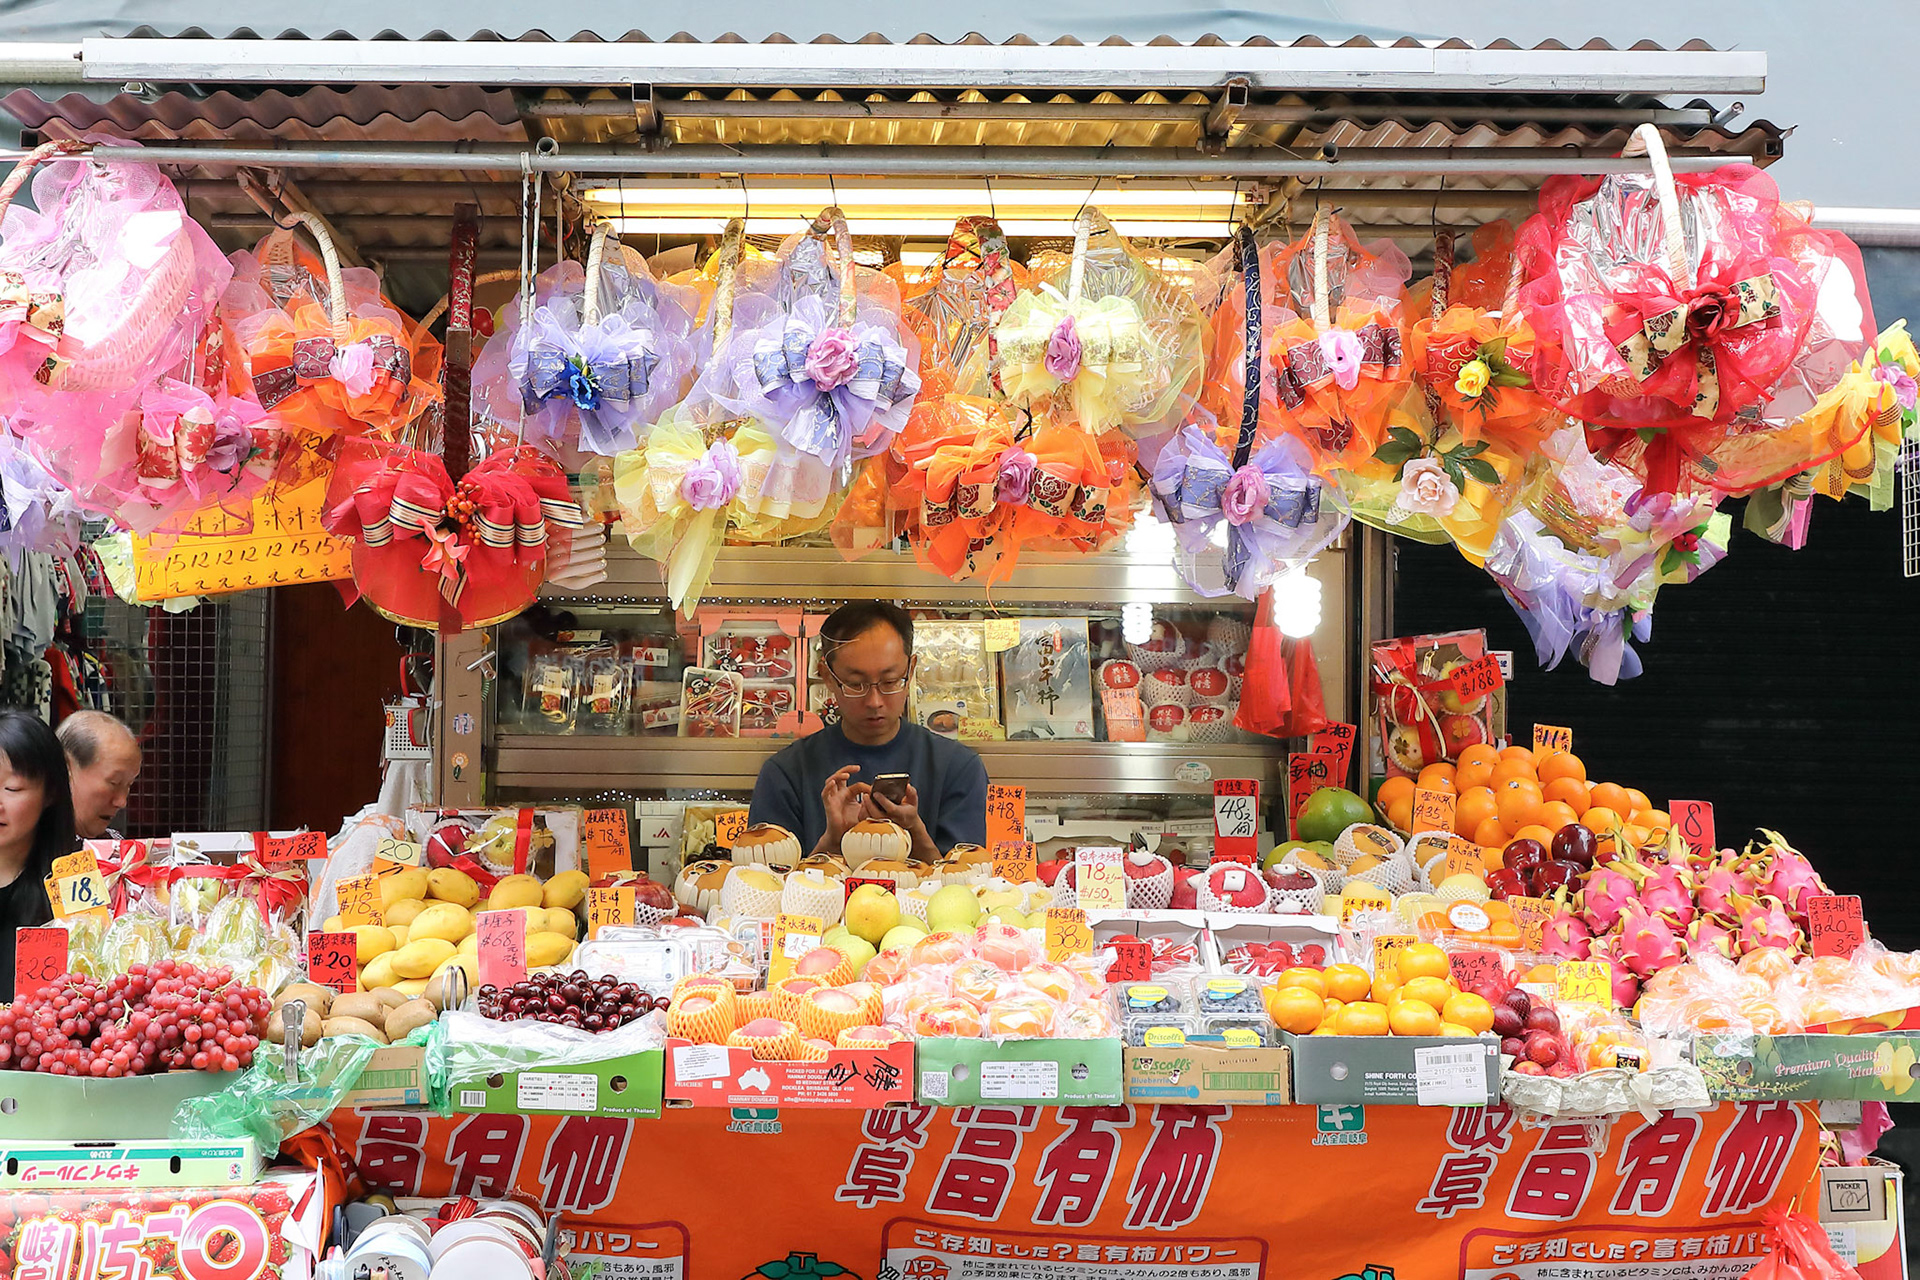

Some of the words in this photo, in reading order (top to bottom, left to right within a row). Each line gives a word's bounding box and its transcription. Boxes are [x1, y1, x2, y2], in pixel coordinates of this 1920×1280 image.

[190, 549, 209, 568] 12
[215, 549, 235, 566] 12
[240, 546, 260, 563] 12
[266, 541, 284, 557] 12
[291, 539, 311, 555] 15
[315, 538, 336, 556] 15
[1034, 630, 1060, 716] 富山干柿
[1460, 670, 1496, 697] $188
[1219, 797, 1247, 821] 48
[1684, 803, 1703, 838] 8
[378, 837, 414, 861] 20
[1081, 863, 1106, 881] 78
[71, 876, 93, 903] 18
[1079, 887, 1110, 900] $150
[339, 892, 373, 915] $18
[26, 955, 60, 982] 28
[312, 950, 353, 970] $20
[1147, 1033, 1182, 1041] Driscoll's
[1774, 1058, 1832, 1078] Premium
[1834, 1049, 1881, 1067] Quality
[1848, 1064, 1890, 1080] Mango
[727, 1122, 783, 1134] JA全農岐阜
[1312, 1132, 1368, 1146] JA全農岐阜
[20, 1163, 141, 1182] キウイフルーツ
[903, 1259, 952, 1273] パワー
